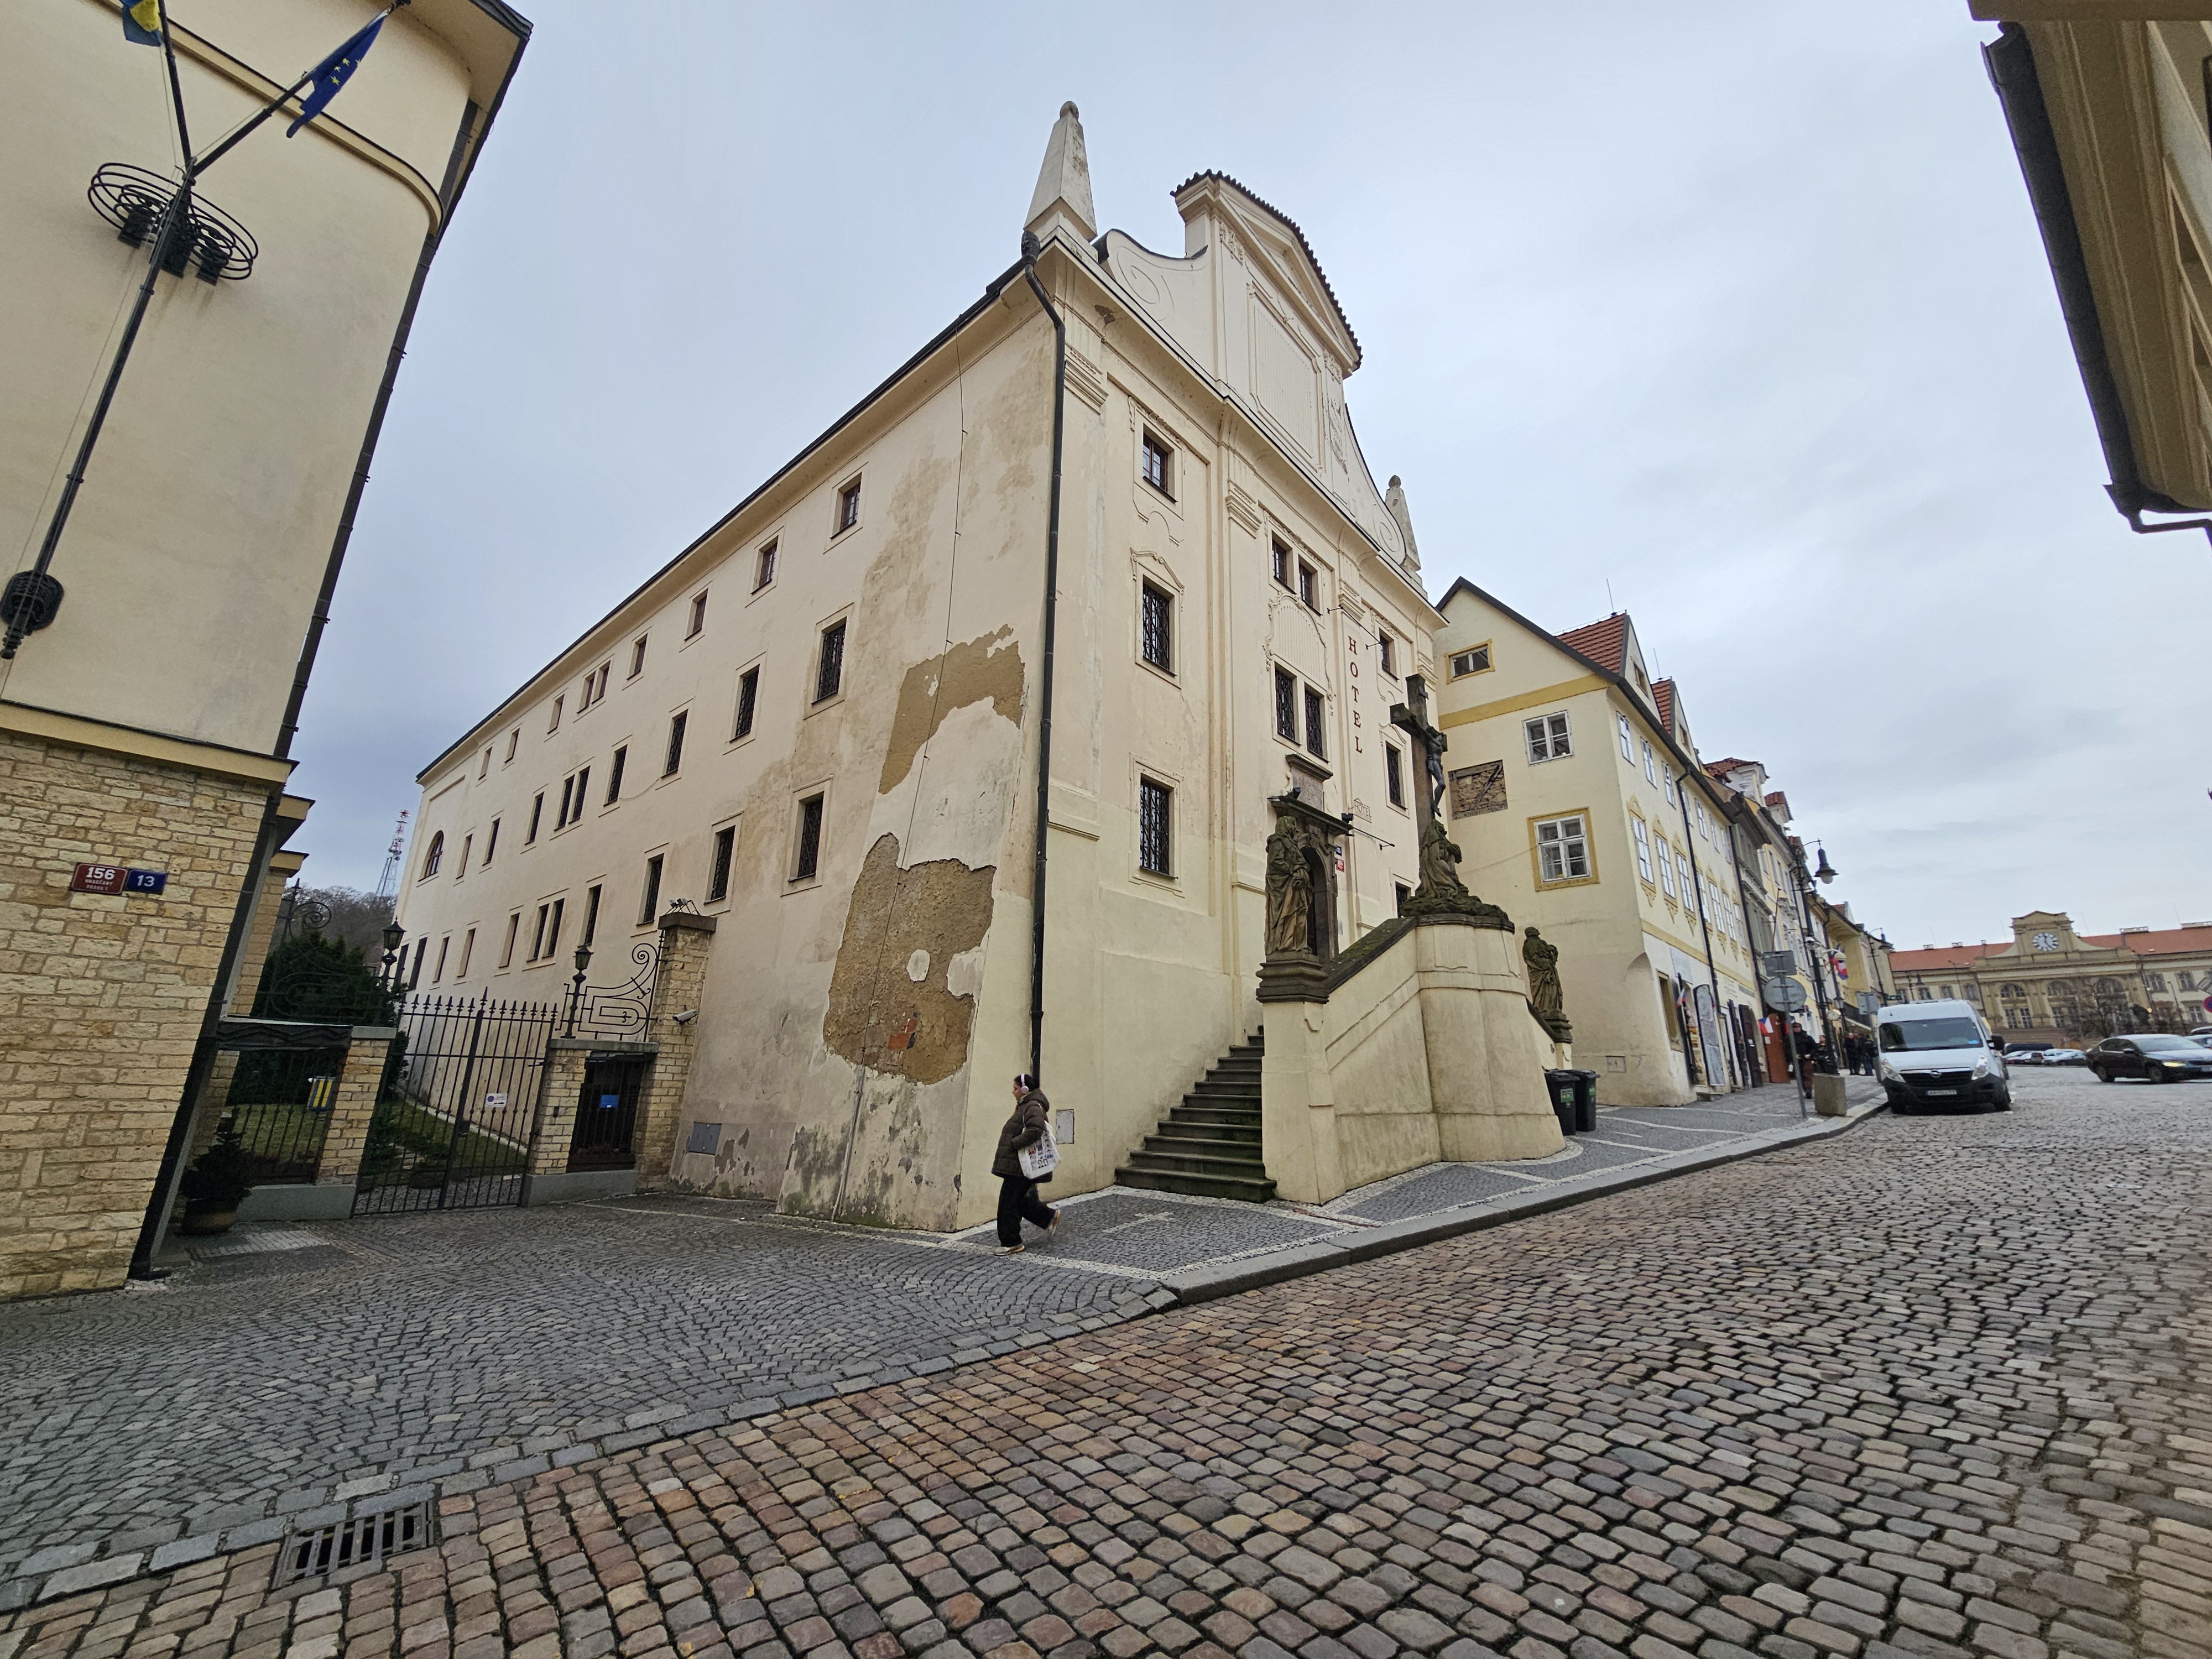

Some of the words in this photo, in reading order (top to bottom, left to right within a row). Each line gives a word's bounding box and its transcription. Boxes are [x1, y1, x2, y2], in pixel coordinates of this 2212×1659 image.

[1348, 635, 1363, 754] HOTEL
[1354, 802, 1371, 817] HOTEL
[86, 867, 116, 880] 156
[137, 875, 155, 887] 13
